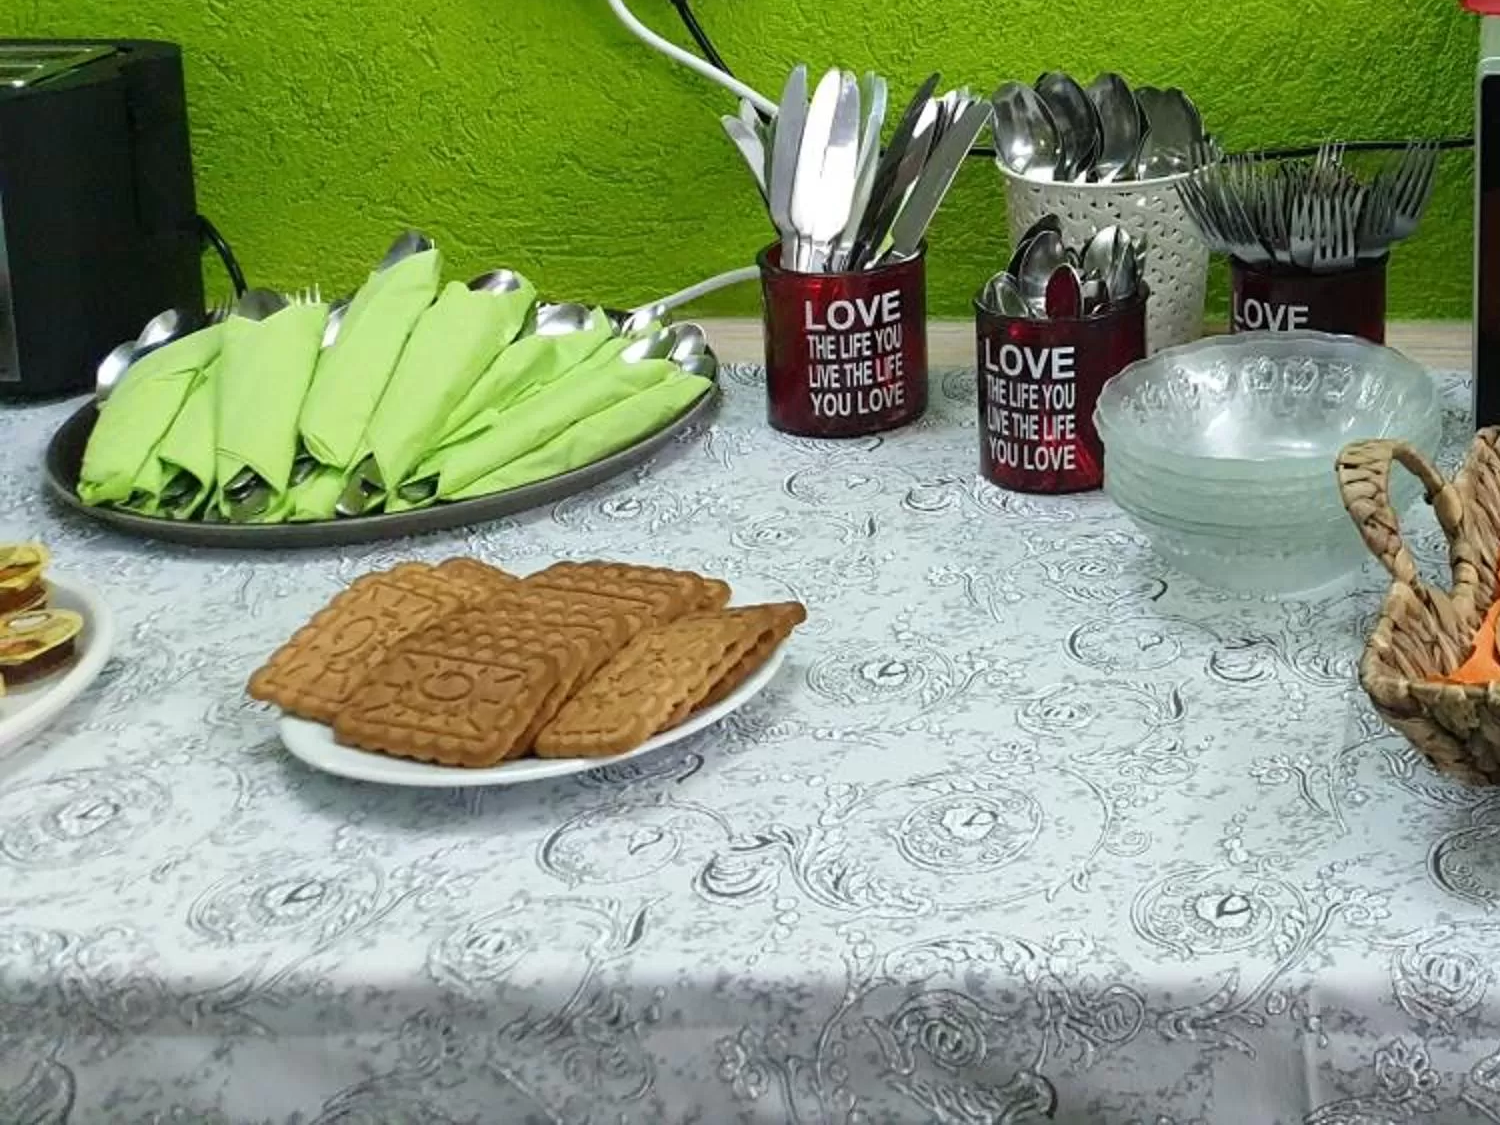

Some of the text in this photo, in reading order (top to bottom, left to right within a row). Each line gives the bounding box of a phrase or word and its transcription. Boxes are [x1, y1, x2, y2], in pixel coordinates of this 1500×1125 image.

[805, 289, 901, 330] LOVE
[1233, 292, 1309, 331] LOVE
[807, 322, 902, 360] THE LIFE YOU
[985, 337, 1076, 380] LOVE
[808, 353, 903, 388] LIVE THE LIFE
[810, 381, 904, 417] YOU LOVE
[987, 375, 1076, 410] THE LIFE YOU
[987, 404, 1076, 440] LIVE THE LIFE
[989, 436, 1076, 471] YOU LOVE
